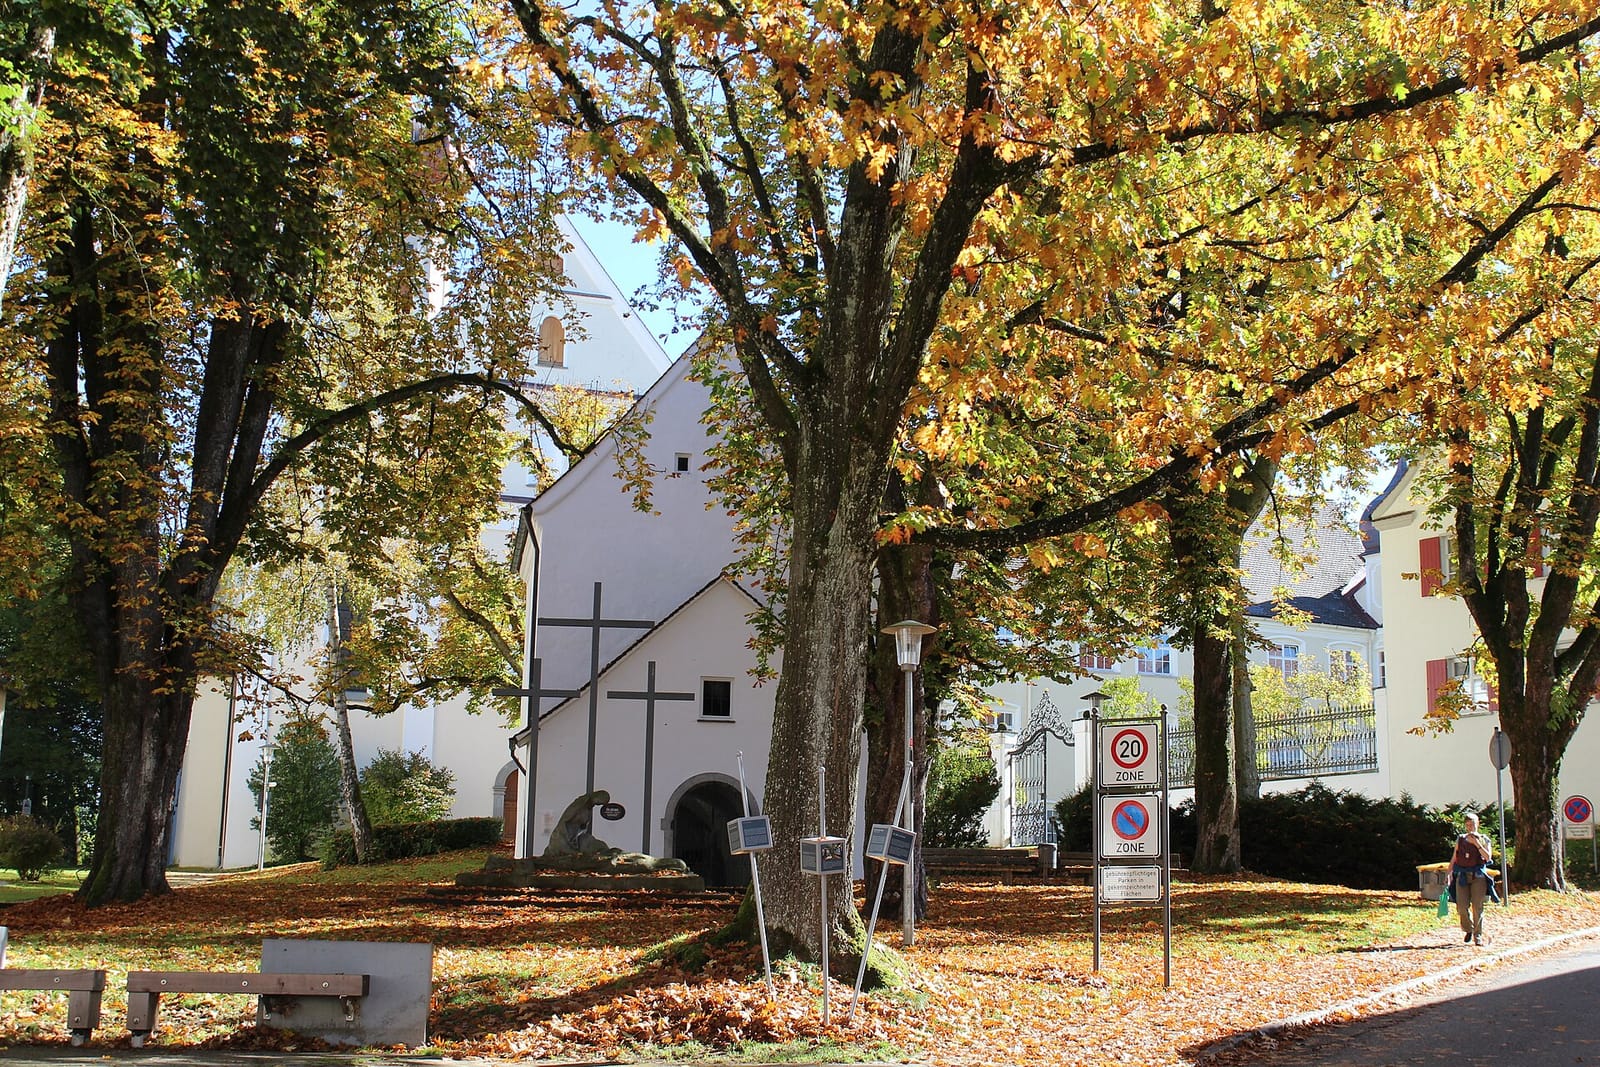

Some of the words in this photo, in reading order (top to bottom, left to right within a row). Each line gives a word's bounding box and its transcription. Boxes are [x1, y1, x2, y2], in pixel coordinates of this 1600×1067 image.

[1120, 740, 1141, 758] 20
[1116, 771, 1144, 781] ZONE
[1117, 843, 1144, 852] ZONE
